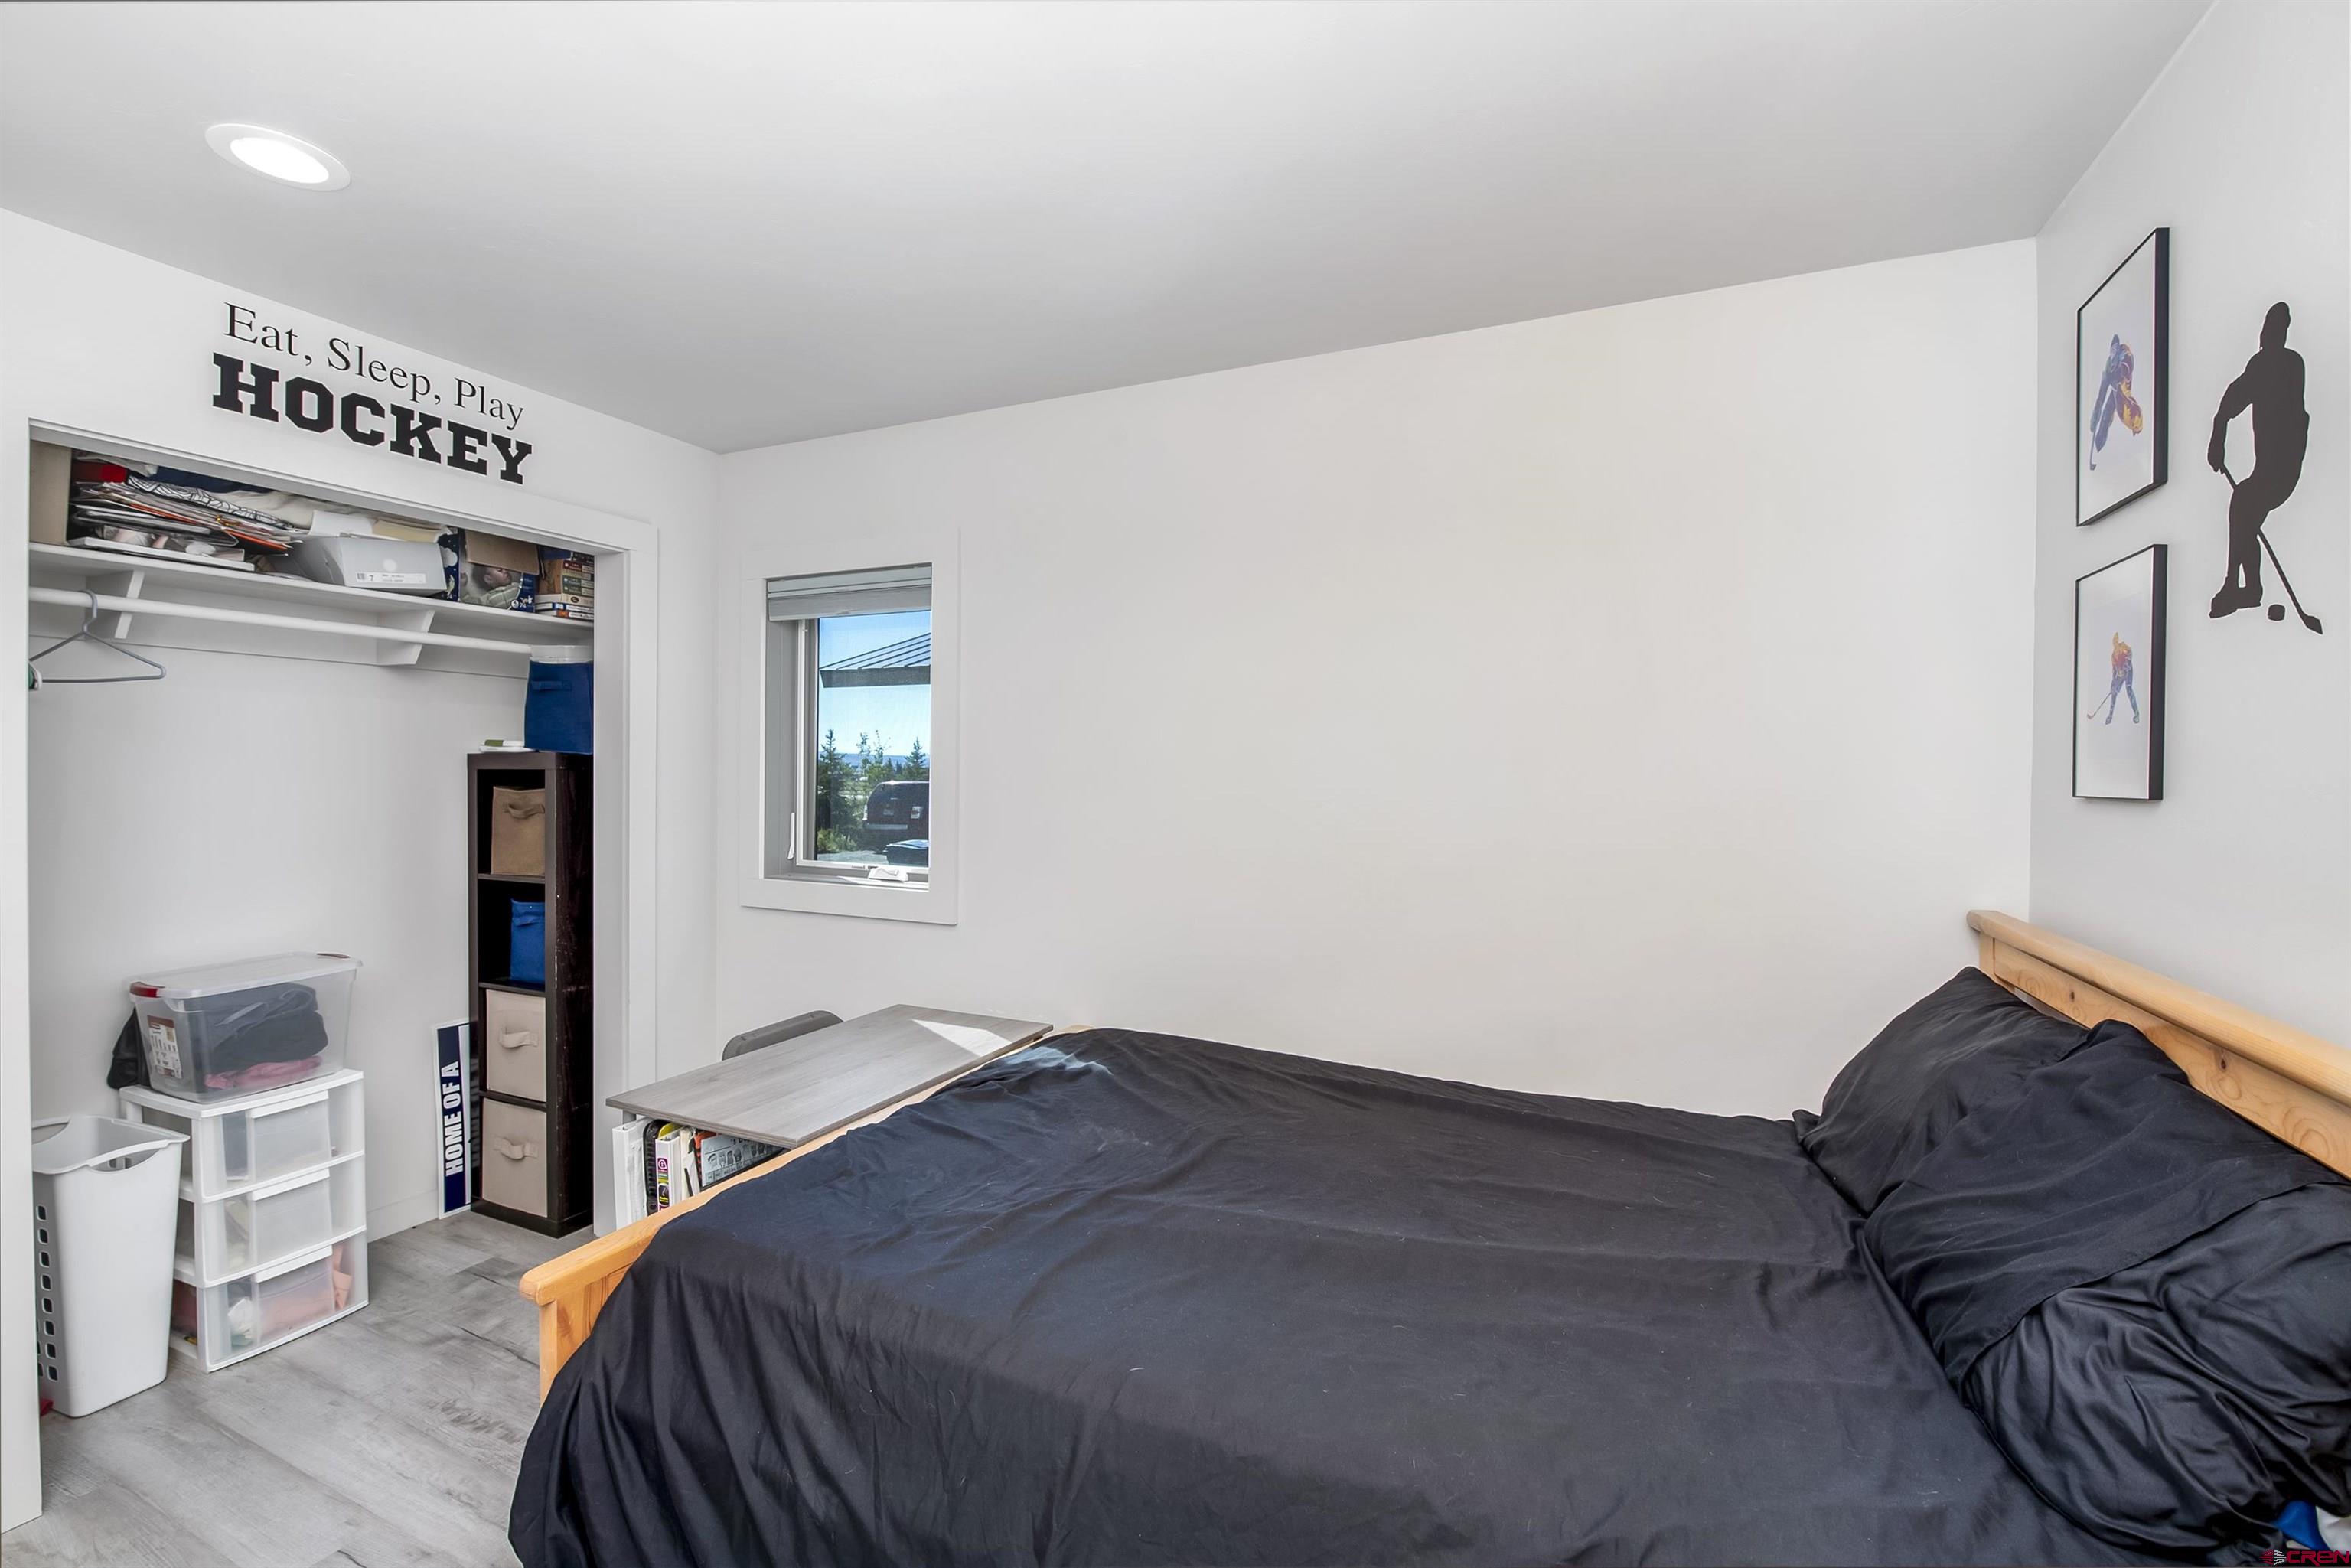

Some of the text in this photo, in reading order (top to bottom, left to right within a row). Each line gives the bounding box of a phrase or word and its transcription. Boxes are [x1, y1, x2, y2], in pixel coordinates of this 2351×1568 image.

[213, 351, 533, 485] HOCKEY
[223, 302, 524, 431] Eat, Sleep, Play
[441, 1061, 464, 1177] HOME OF A
